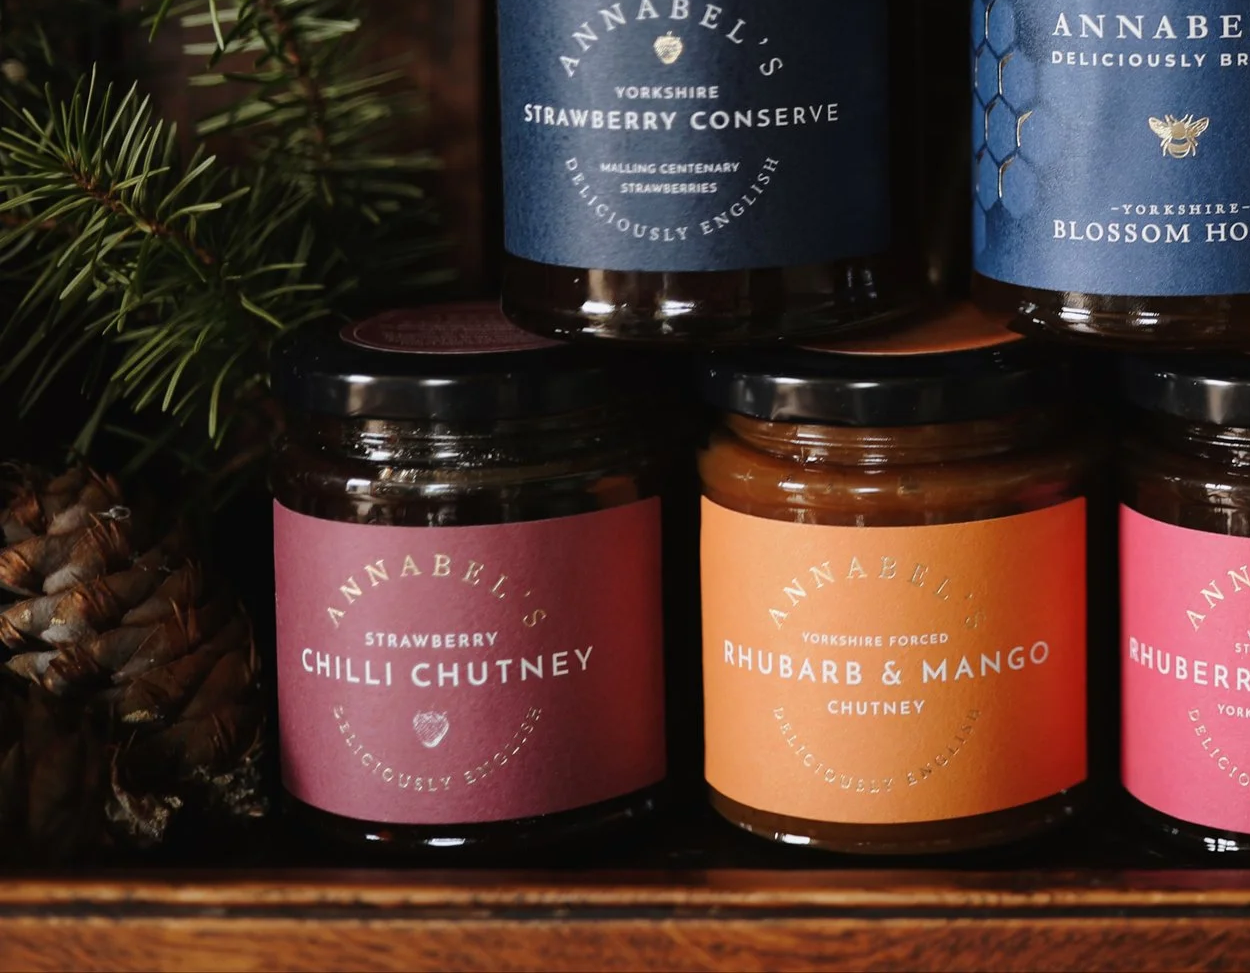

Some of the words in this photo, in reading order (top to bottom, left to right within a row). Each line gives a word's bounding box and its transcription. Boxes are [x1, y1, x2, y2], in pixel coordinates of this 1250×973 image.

[1051, 49, 1207, 69] DELICIOUSLY
[614, 85, 720, 100] YORKSHIRE
[523, 103, 677, 131] STRAWBERRY
[689, 102, 840, 131] CONSERVE
[600, 161, 657, 175] MALLING
[658, 161, 741, 175] CENTENARY
[564, 156, 689, 242] DELICIOUSLY
[700, 156, 780, 236] ENGLISH
[620, 181, 718, 195] STRAWBERRIES
[1052, 219, 1192, 244] BLOSSOM
[326, 553, 548, 629] ANNABEL'S
[364, 631, 498, 649] STRAWBERRY
[801, 631, 883, 648] YORKSHIRE
[889, 632, 949, 647] FORCED
[301, 647, 393, 687] CHILLI
[410, 645, 595, 688] CHUTNEY
[723, 639, 864, 686] RHUBARB
[881, 663, 902, 686] &
[921, 640, 1051, 684] MANGO
[827, 699, 926, 716] CHUTNEY
[773, 705, 895, 794] DELICIOUSLY
